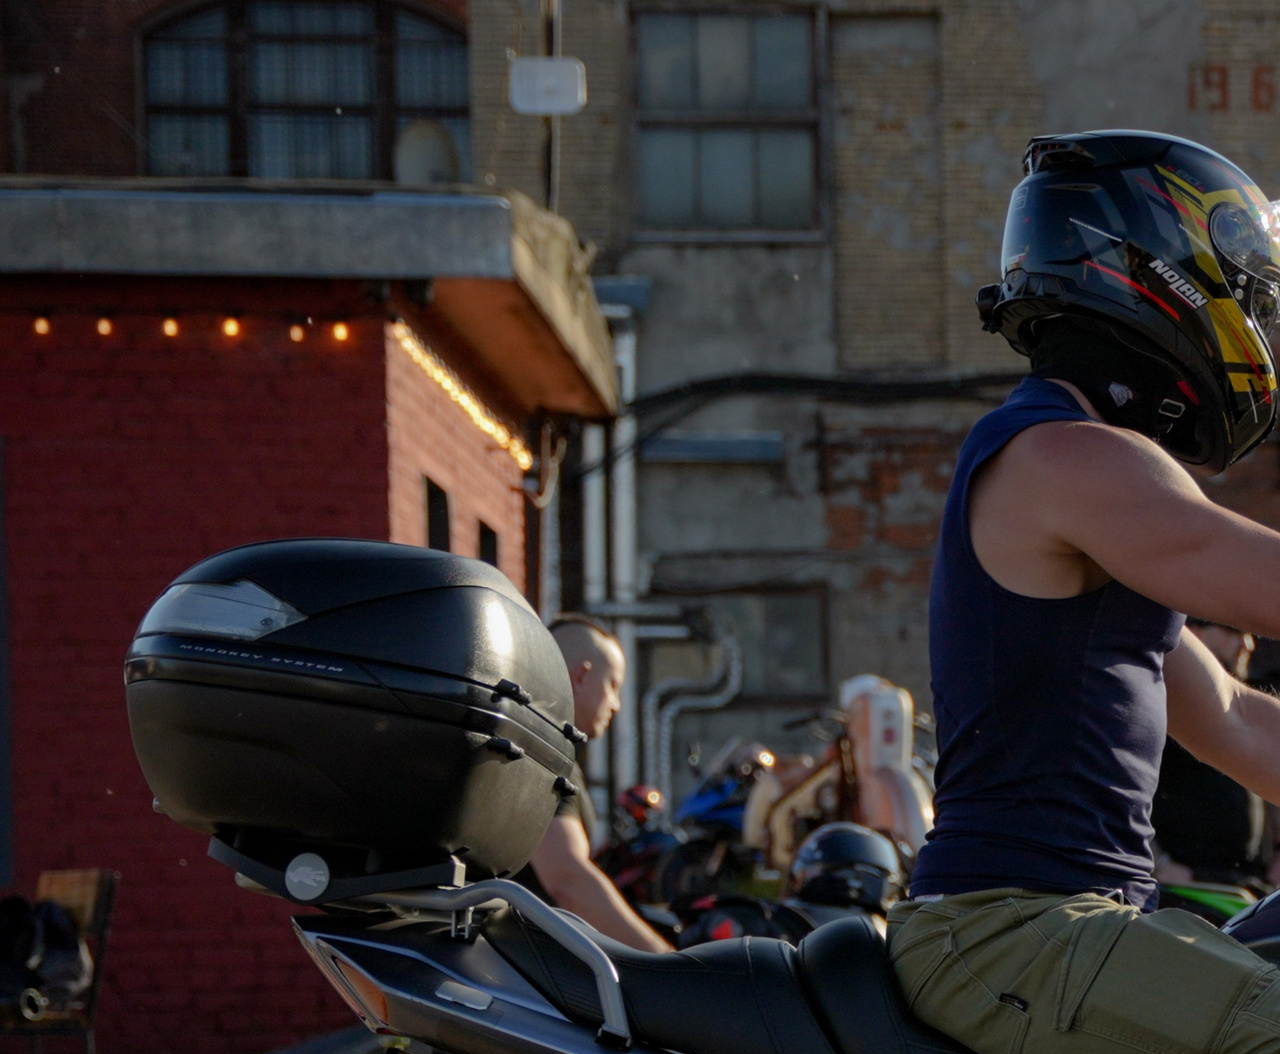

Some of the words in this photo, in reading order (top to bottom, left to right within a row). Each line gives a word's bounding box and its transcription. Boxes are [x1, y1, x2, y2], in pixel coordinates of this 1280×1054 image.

[1149, 258, 1209, 310] NOLAN
[180, 644, 263, 659] MONOKEY
[271, 657, 343, 672] SYSTEM
